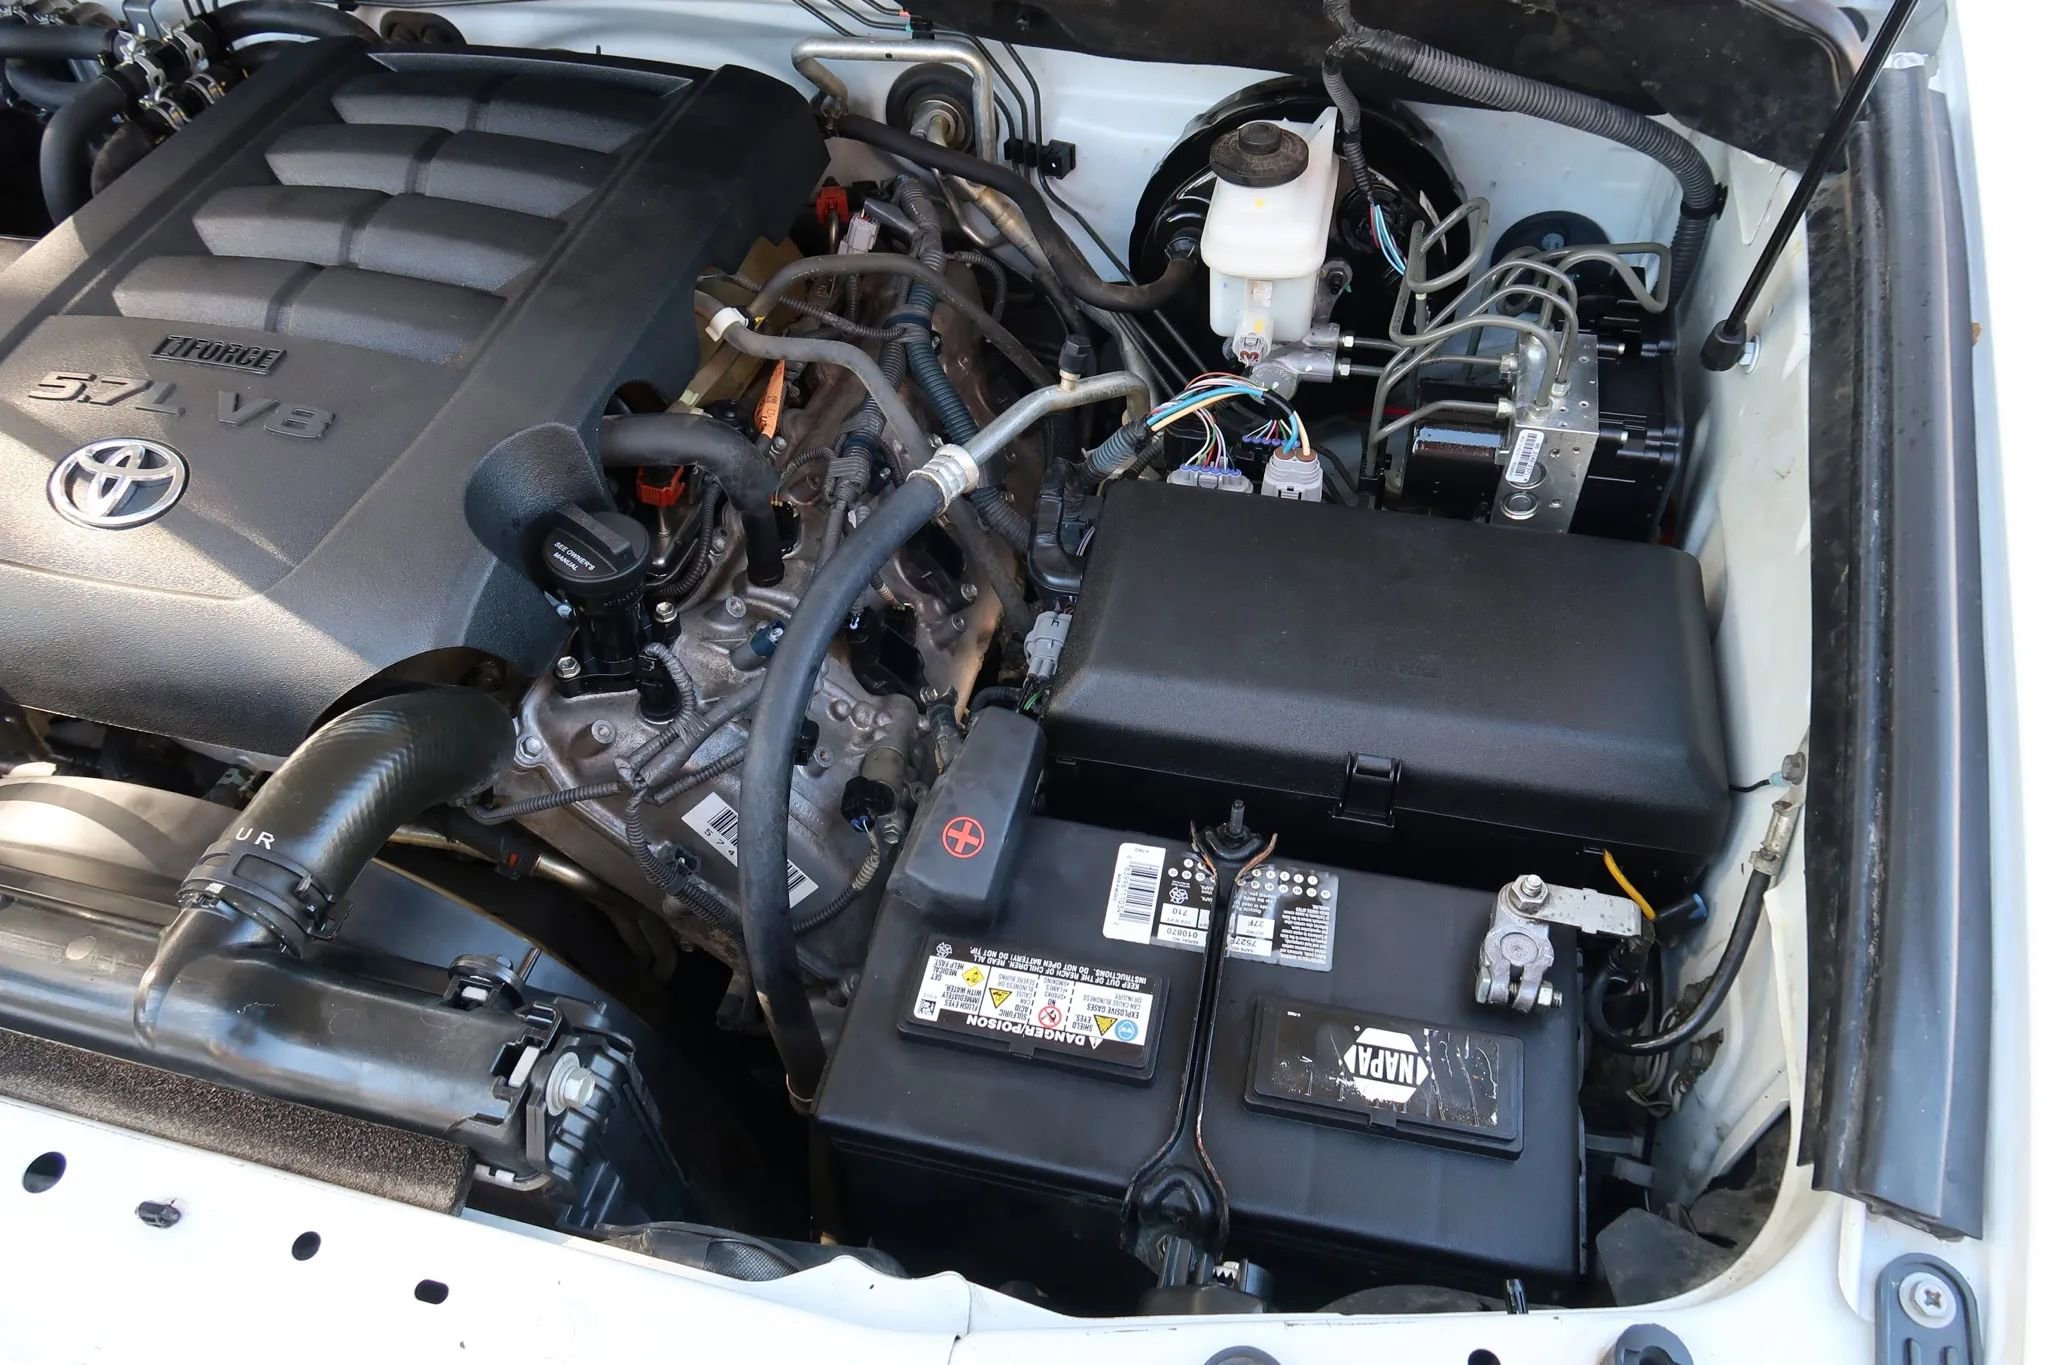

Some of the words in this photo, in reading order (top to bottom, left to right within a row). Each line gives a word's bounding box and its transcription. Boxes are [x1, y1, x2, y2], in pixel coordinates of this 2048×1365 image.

[29, 371, 184, 416] 5.7L
[218, 390, 337, 440] V8
[553, 541, 568, 553] SEE
[566, 548, 596, 571] OWNER'S
[552, 551, 580, 572] MANUAL
[1172, 907, 1187, 916] 710
[1247, 918, 1263, 927] 27F
[1166, 927, 1197, 938] 010870
[969, 946, 981, 954] TIP.
[982, 948, 997, 957] NOT
[972, 954, 985, 962] ALL
[998, 951, 1008, 959] DO
[933, 958, 949, 967] FAST.
[950, 961, 964, 969] HELP
[986, 956, 1005, 966] READ
[1042, 959, 1061, 969] OPEN
[932, 965, 957, 976] MEDICAL
[1006, 960, 1043, 973] CHILDREN.
[1045, 967, 1054, 975] OF
[1062, 962, 1077, 971] NOT
[1078, 965, 1089, 973] DO
[930, 972, 942, 980] GET
[1055, 969, 1079, 979] REACH
[1080, 973, 1093, 982] THE
[1092, 968, 1146, 984] INSTRUCTIONS.
[1094, 976, 1104, 984] OF
[1105, 977, 1120, 986] OUT
[943, 984, 965, 993] WATER.
[1121, 980, 1139, 990] KEEP
[941, 990, 980, 1003] IMMEDIATELY
[966, 988, 981, 996] WITH
[943, 999, 959, 1007] EYES
[1082, 994, 1111, 1005] BLINDNESS
[1112, 999, 1129, 1008] CAUSE
[959, 1002, 978, 1011] FLUSH
[1014, 1003, 1028, 1012] ACID
[1086, 1002, 1105, 1012] GASES
[1129, 1002, 1140, 1010] CAN
[998, 1008, 1027, 1020] SULFURIC
[1107, 1006, 1139, 1018] EXPLOSIVE
[965, 1014, 1086, 1045] DANGER/POISON
[1071, 1021, 1093, 1031] SHIELD
[1358, 1044, 1414, 1085] NAPA
